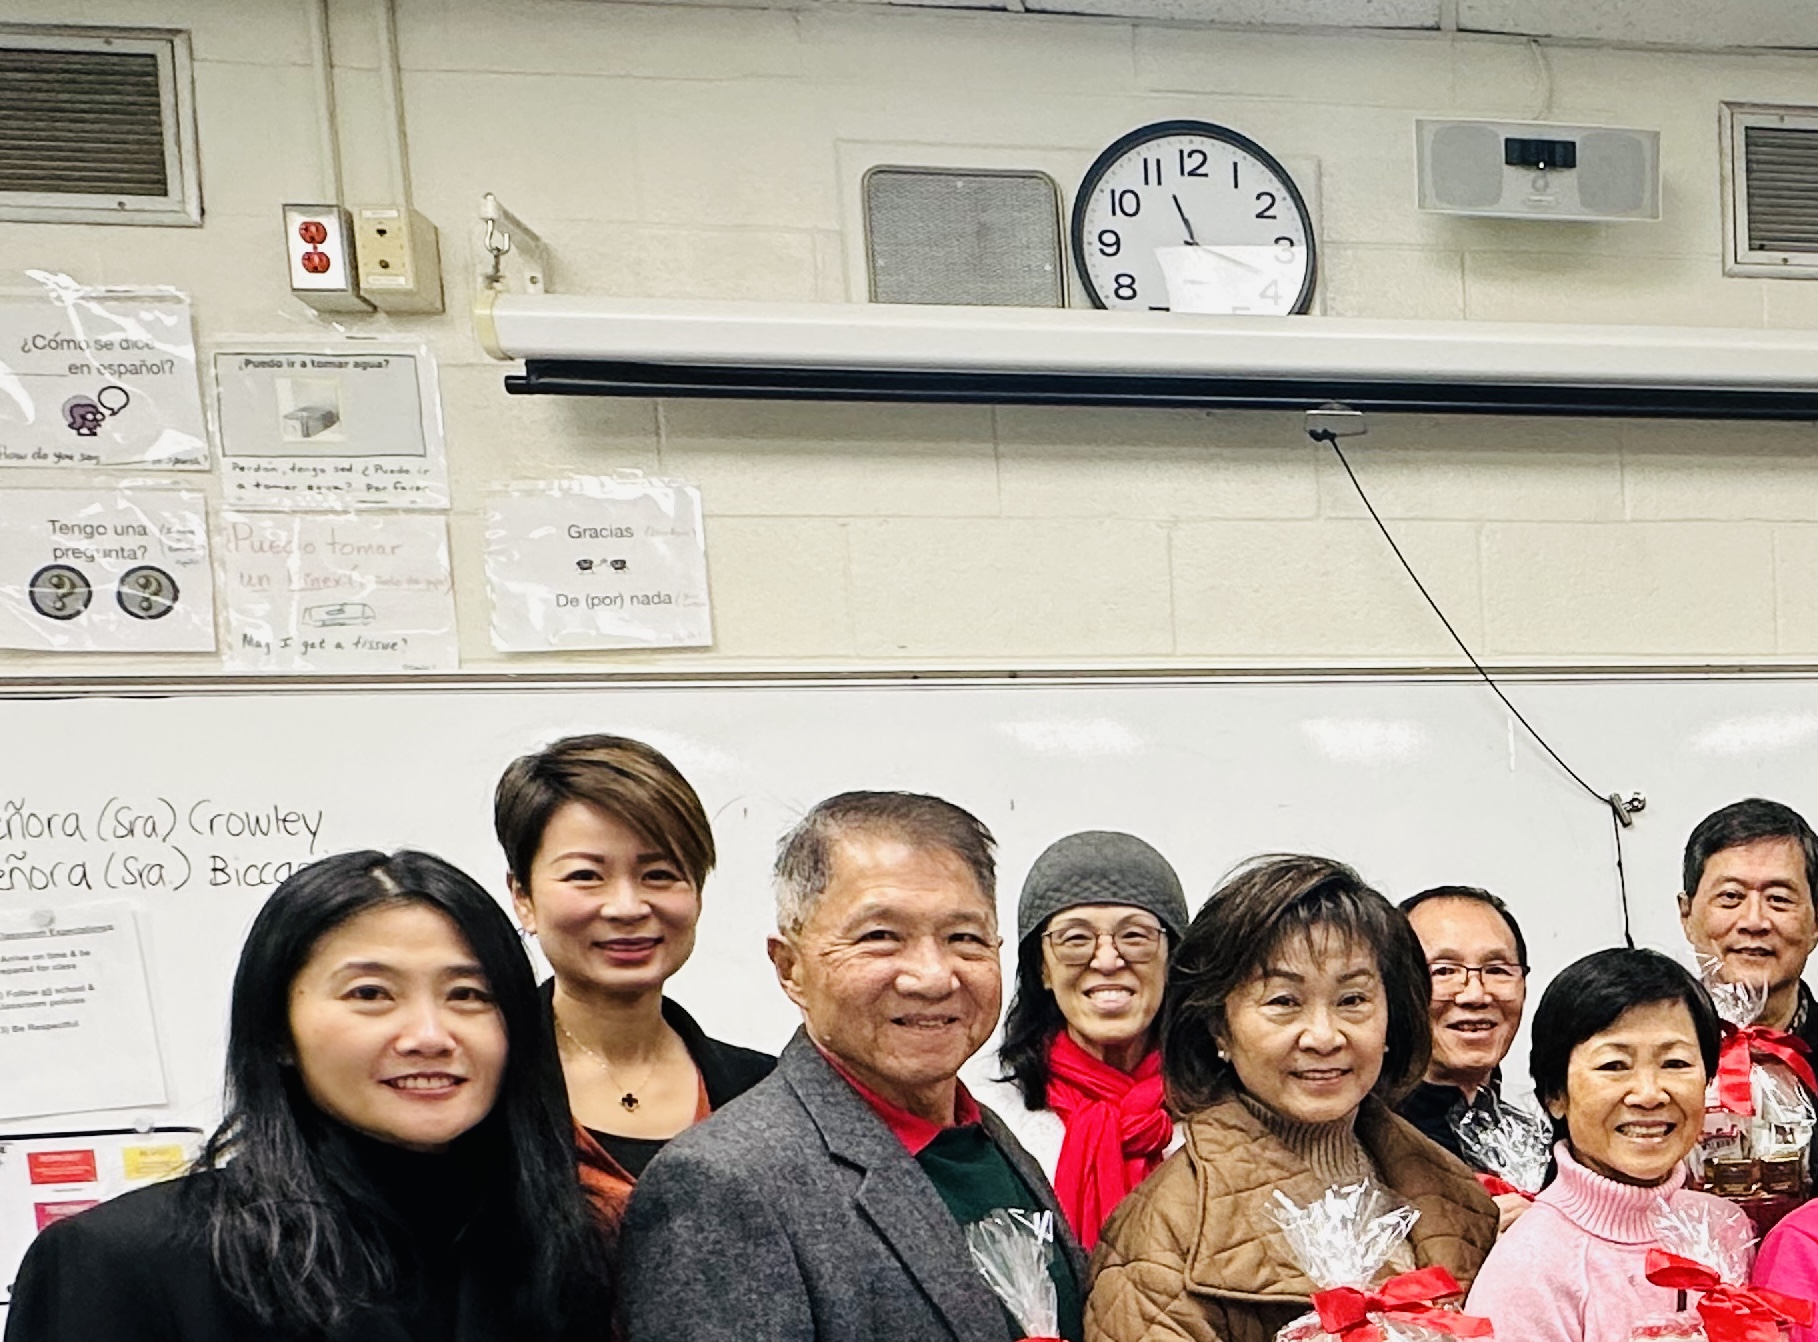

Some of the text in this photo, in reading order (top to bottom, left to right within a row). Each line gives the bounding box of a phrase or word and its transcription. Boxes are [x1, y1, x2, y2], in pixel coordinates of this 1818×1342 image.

[1143, 157, 1162, 186] 11
[1179, 149, 1209, 178] 12
[1232, 161, 1239, 189] 1
[1110, 188, 1141, 217] 10
[1255, 192, 1277, 219] 2
[1098, 229, 1121, 257] 9
[1273, 236, 1296, 264] 3
[1114, 273, 1137, 301] 8
[94, 338, 115, 351] se
[47, 519, 149, 538] Tengo una
[325, 527, 403, 556] tomar
[567, 524, 634, 540] Gracias
[556, 593, 580, 608] De
[585, 593, 625, 610] (por)
[630, 591, 673, 607] nada
[0, 797, 87, 842] ñora
[189, 799, 323, 855] Crowley
